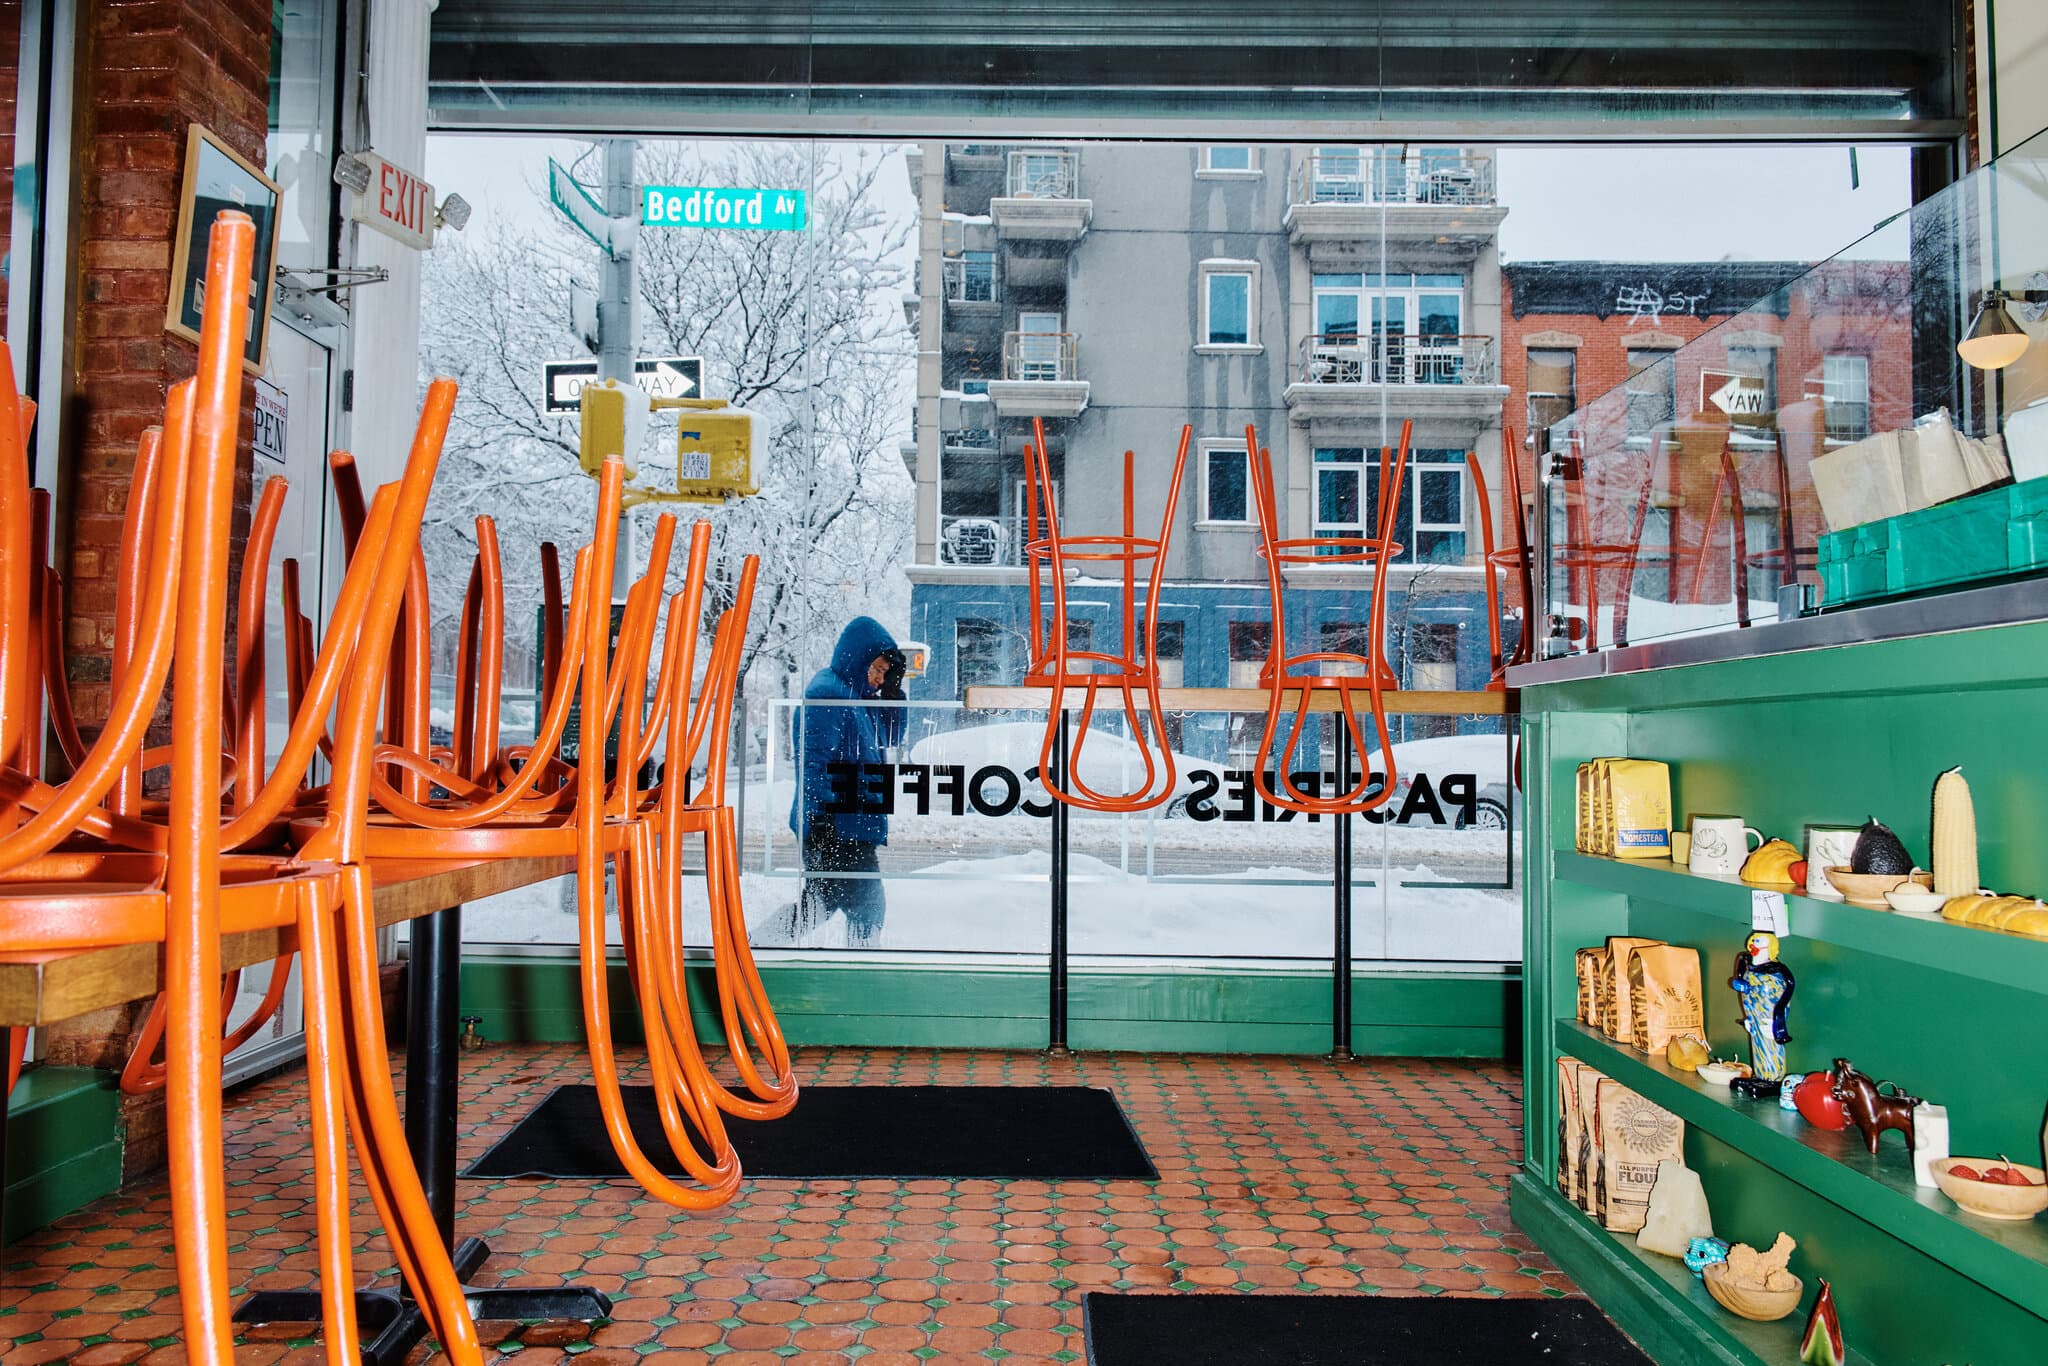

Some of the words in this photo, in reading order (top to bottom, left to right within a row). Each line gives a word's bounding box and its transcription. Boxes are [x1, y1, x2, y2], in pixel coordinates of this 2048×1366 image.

[379, 162, 428, 234] EXIT
[648, 190, 763, 225] Bedford
[774, 195, 796, 215] Av
[253, 406, 284, 454] PEN
[1623, 832, 1664, 843] HOMESTEAD
[1618, 1170, 1656, 1184] FLOU
